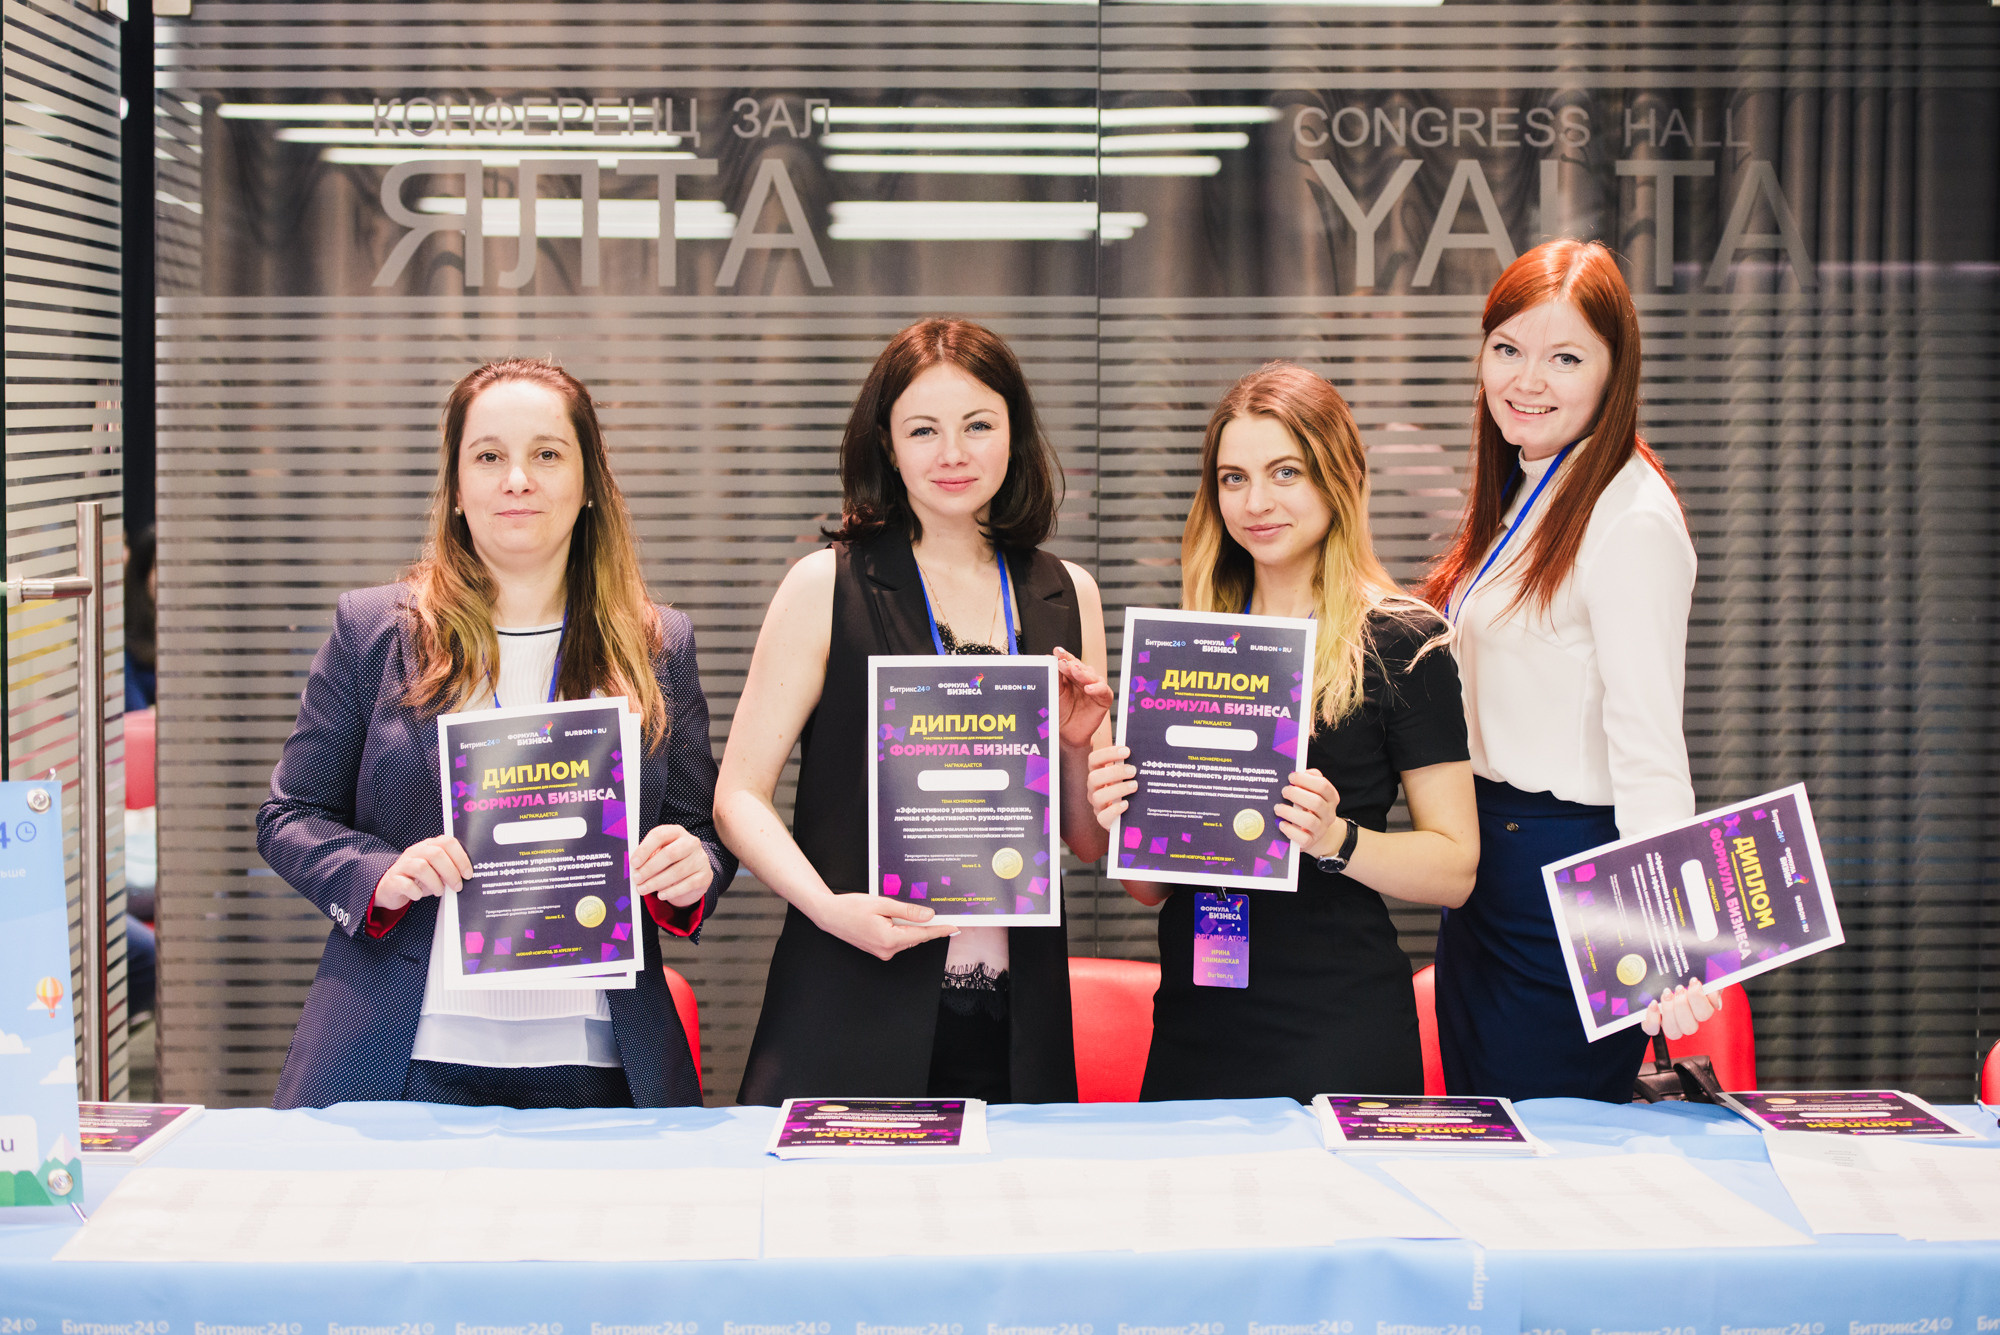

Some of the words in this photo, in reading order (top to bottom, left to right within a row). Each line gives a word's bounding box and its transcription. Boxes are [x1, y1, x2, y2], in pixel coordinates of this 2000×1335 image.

[373, 97, 701, 146] КОНФЕРЕНЦ
[732, 97, 831, 139] ЗАЛ
[1293, 107, 1590, 148] CONGRESS
[1625, 107, 1751, 148] HALL
[371, 158, 834, 288] ЯЛТА
[1202, 645, 1237, 654] БИЗНЕСА
[1162, 669, 1269, 693] ДИПЛОМ
[1140, 697, 1220, 714] ФОРМУЛА
[1224, 703, 1291, 719] БИЗНЕСА
[910, 714, 1016, 735] ДИПЛОМ
[508, 732, 539, 740] ФОРМУЛА
[517, 736, 552, 746] БИЗНЕСА
[890, 743, 970, 756] ФОРМУЛА
[974, 743, 1040, 756] БИЗНЕСА
[482, 759, 590, 790] ДИПЛОМ
[1142, 761, 1196, 770] «Эффективное
[1197, 764, 1241, 773] управление,
[1242, 767, 1277, 776] продажи,
[1166, 770, 1222, 780] эффективность
[463, 793, 545, 812] ФОРМУЛА
[548, 788, 616, 805] БИЗНЕСА
[519, 811, 558, 820] НАГРАЖДАЕТСЯ
[472, 870, 498, 878] личная
[500, 866, 557, 876] эффективность
[558, 860, 613, 871] руководителя»
[474, 860, 528, 870] «Эффективное
[530, 855, 576, 866] управление,
[577, 852, 611, 861] продажи,
[1785, 846, 1796, 874] ФОРМУЛА
[1779, 856, 1794, 888] БИЗНЕСА
[1733, 836, 1775, 929] ДИПЛОМ
[1710, 828, 1736, 898] ФОРМУЛА
[1726, 897, 1752, 960] БИЗНЕСА
[1208, 912, 1242, 920] БИЗНЕСА
[0, 1318, 23, 1333] 24
[62, 1319, 154, 1335] Битрикс24
[1848, 1317, 1939, 1335] Битрикс24
[1977, 1315, 2000, 1331] Би
